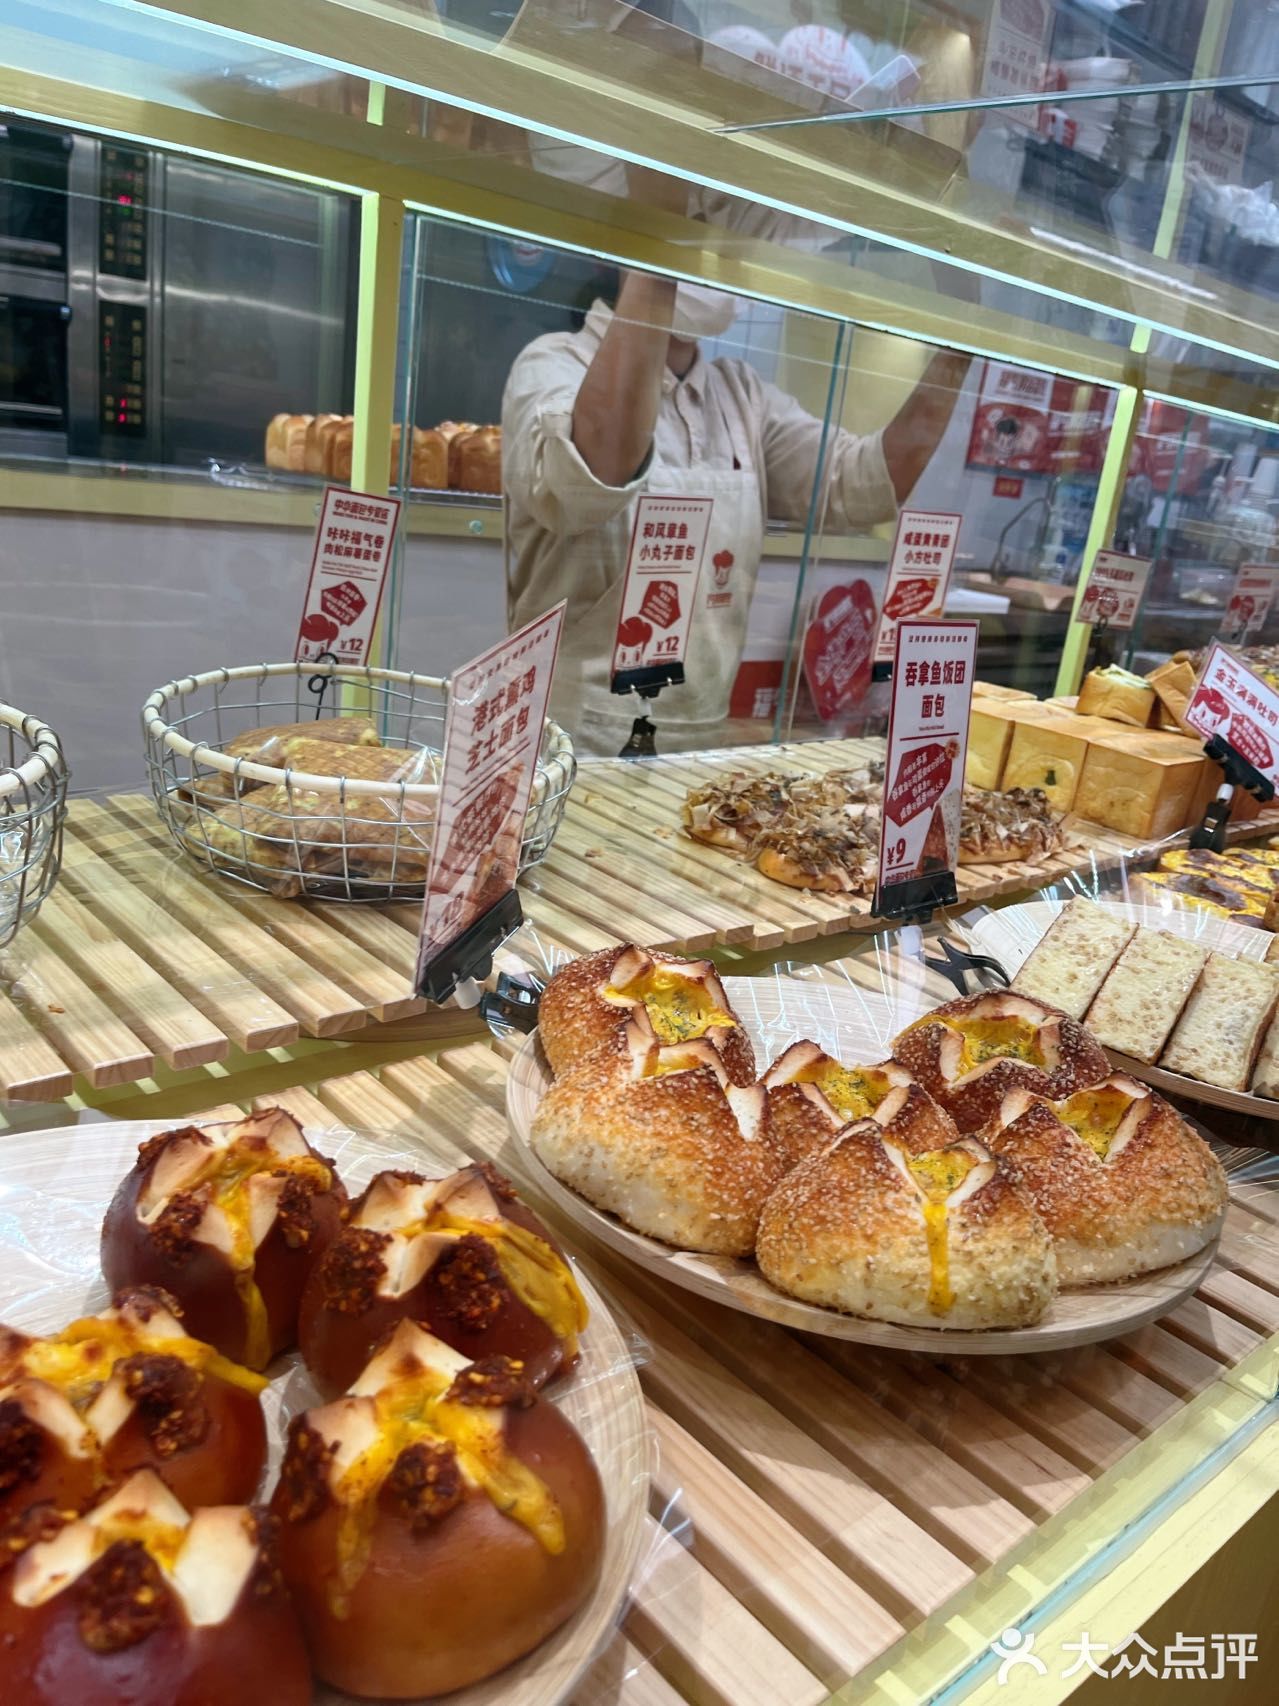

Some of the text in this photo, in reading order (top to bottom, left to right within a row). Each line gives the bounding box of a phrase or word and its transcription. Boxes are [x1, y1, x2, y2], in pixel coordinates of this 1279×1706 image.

[642, 522, 688, 540] 和风章鱼
[639, 545, 695, 561] 小丸子面包
[341, 638, 364, 651] ¥12
[656, 636, 680, 652] ¥12
[905, 660, 966, 687] 吞拿鱼饭团
[921, 693, 946, 718] 面包
[465, 705, 531, 775] 芝士面包
[887, 837, 907, 865] ¥9
